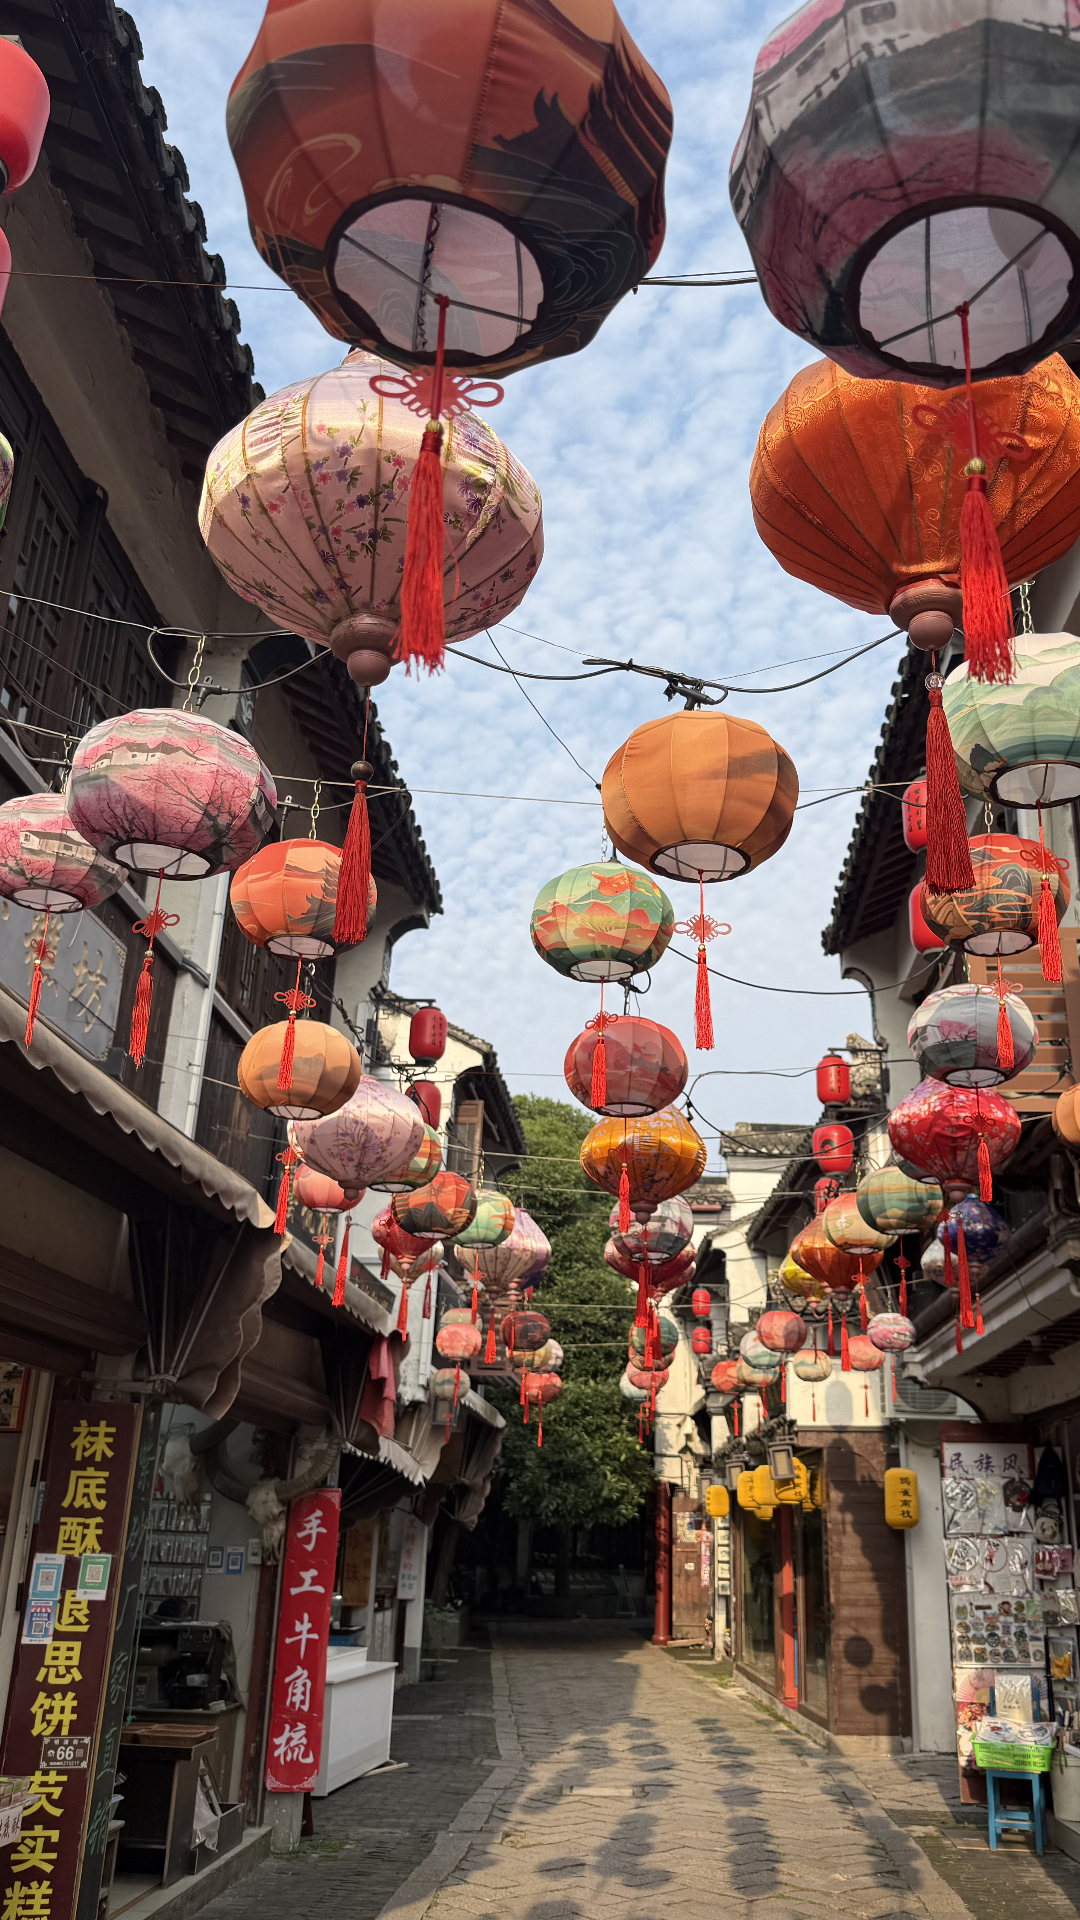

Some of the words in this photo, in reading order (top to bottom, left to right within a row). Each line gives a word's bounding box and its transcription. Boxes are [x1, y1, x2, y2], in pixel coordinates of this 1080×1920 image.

[56, 1419, 117, 1559] 袜底酥
[948, 1451, 1024, 1474] 民族风
[30, 1589, 91, 1737] 退思饼
[272, 1508, 328, 1766] 手工牛角梳
[56, 1745, 75, 1761] 66
[2, 1770, 68, 1920] 芡实糕
